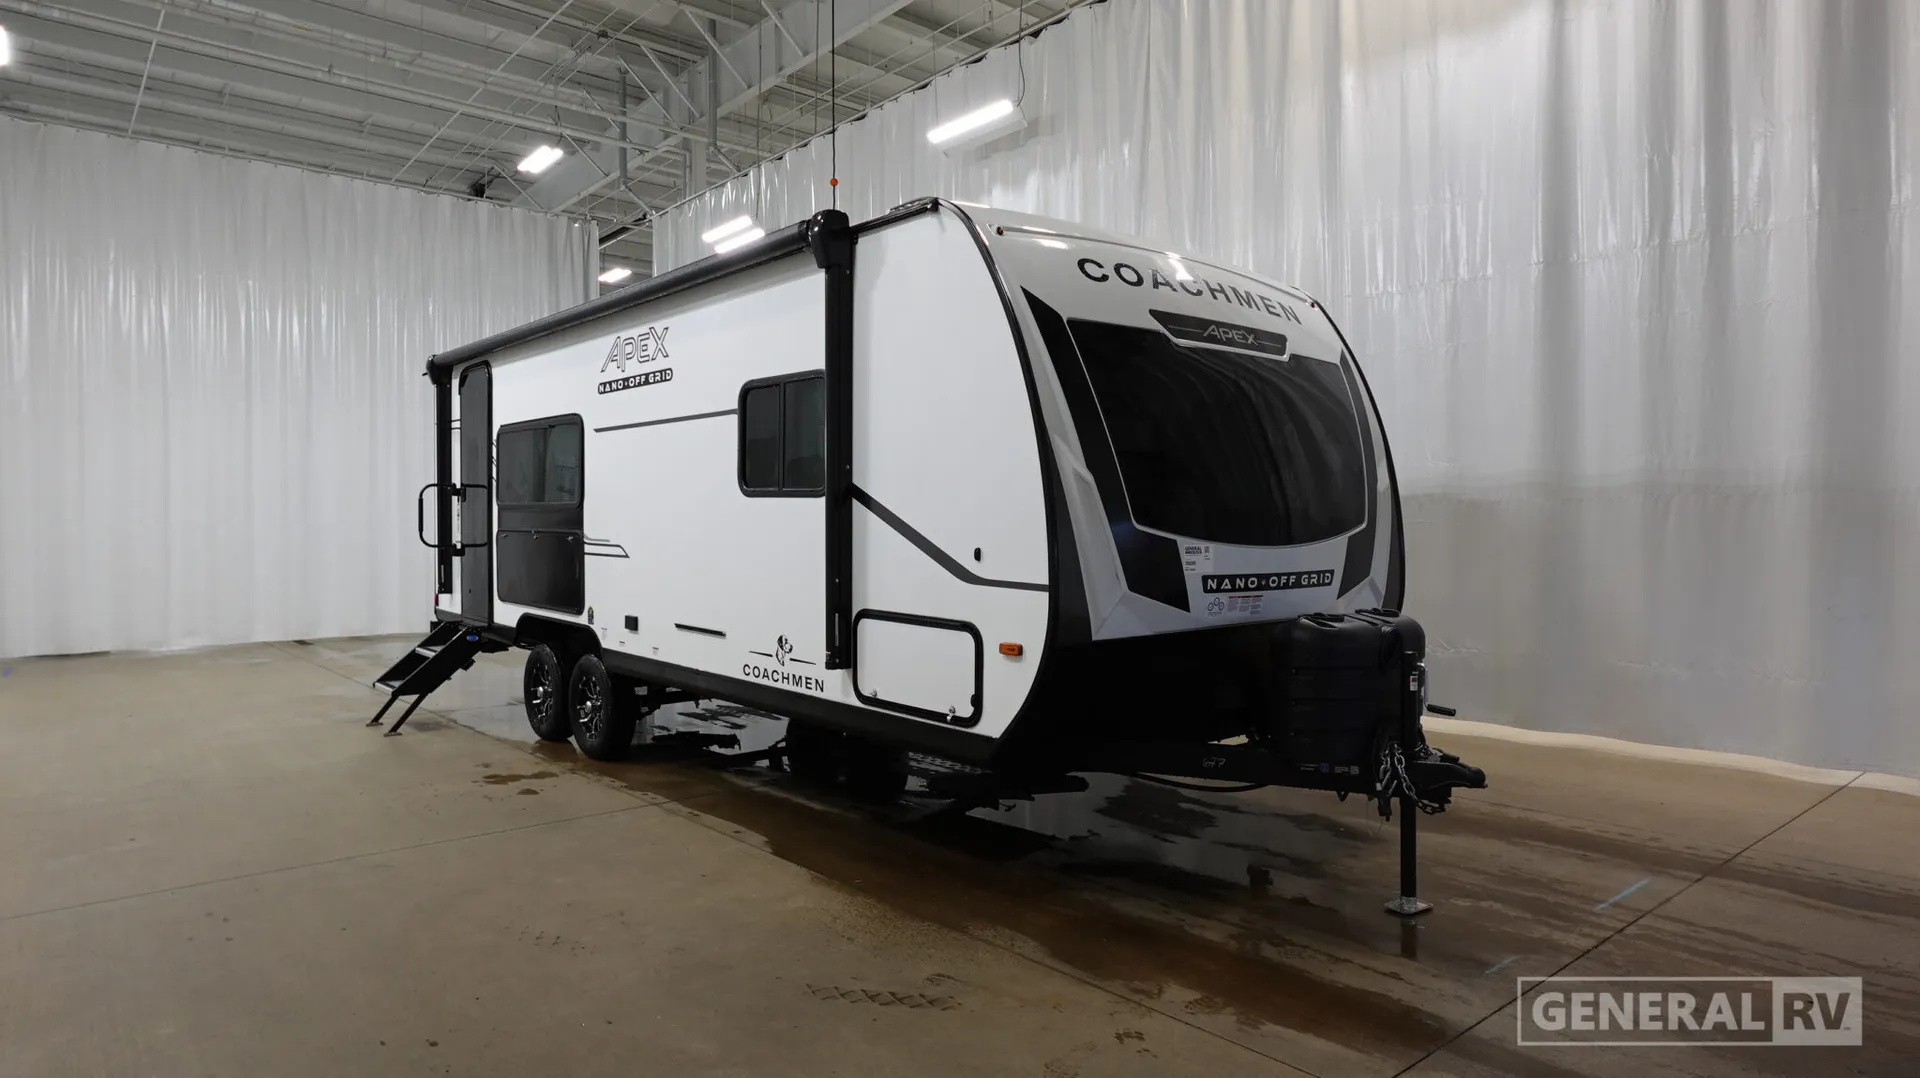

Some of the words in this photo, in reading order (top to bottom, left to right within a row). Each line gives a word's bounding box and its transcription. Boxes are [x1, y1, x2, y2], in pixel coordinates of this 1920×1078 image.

[1077, 257, 1302, 325] COACHMEN
[1203, 324, 1258, 346] APEX
[600, 326, 669, 373] APEX
[599, 380, 624, 393] NANO
[628, 375, 646, 387] OFF
[648, 370, 672, 383] GRID
[1207, 577, 1258, 590] NANO
[1269, 575, 1297, 587] OFF
[1301, 573, 1332, 585] GRID
[743, 663, 824, 693] COACHMEN
